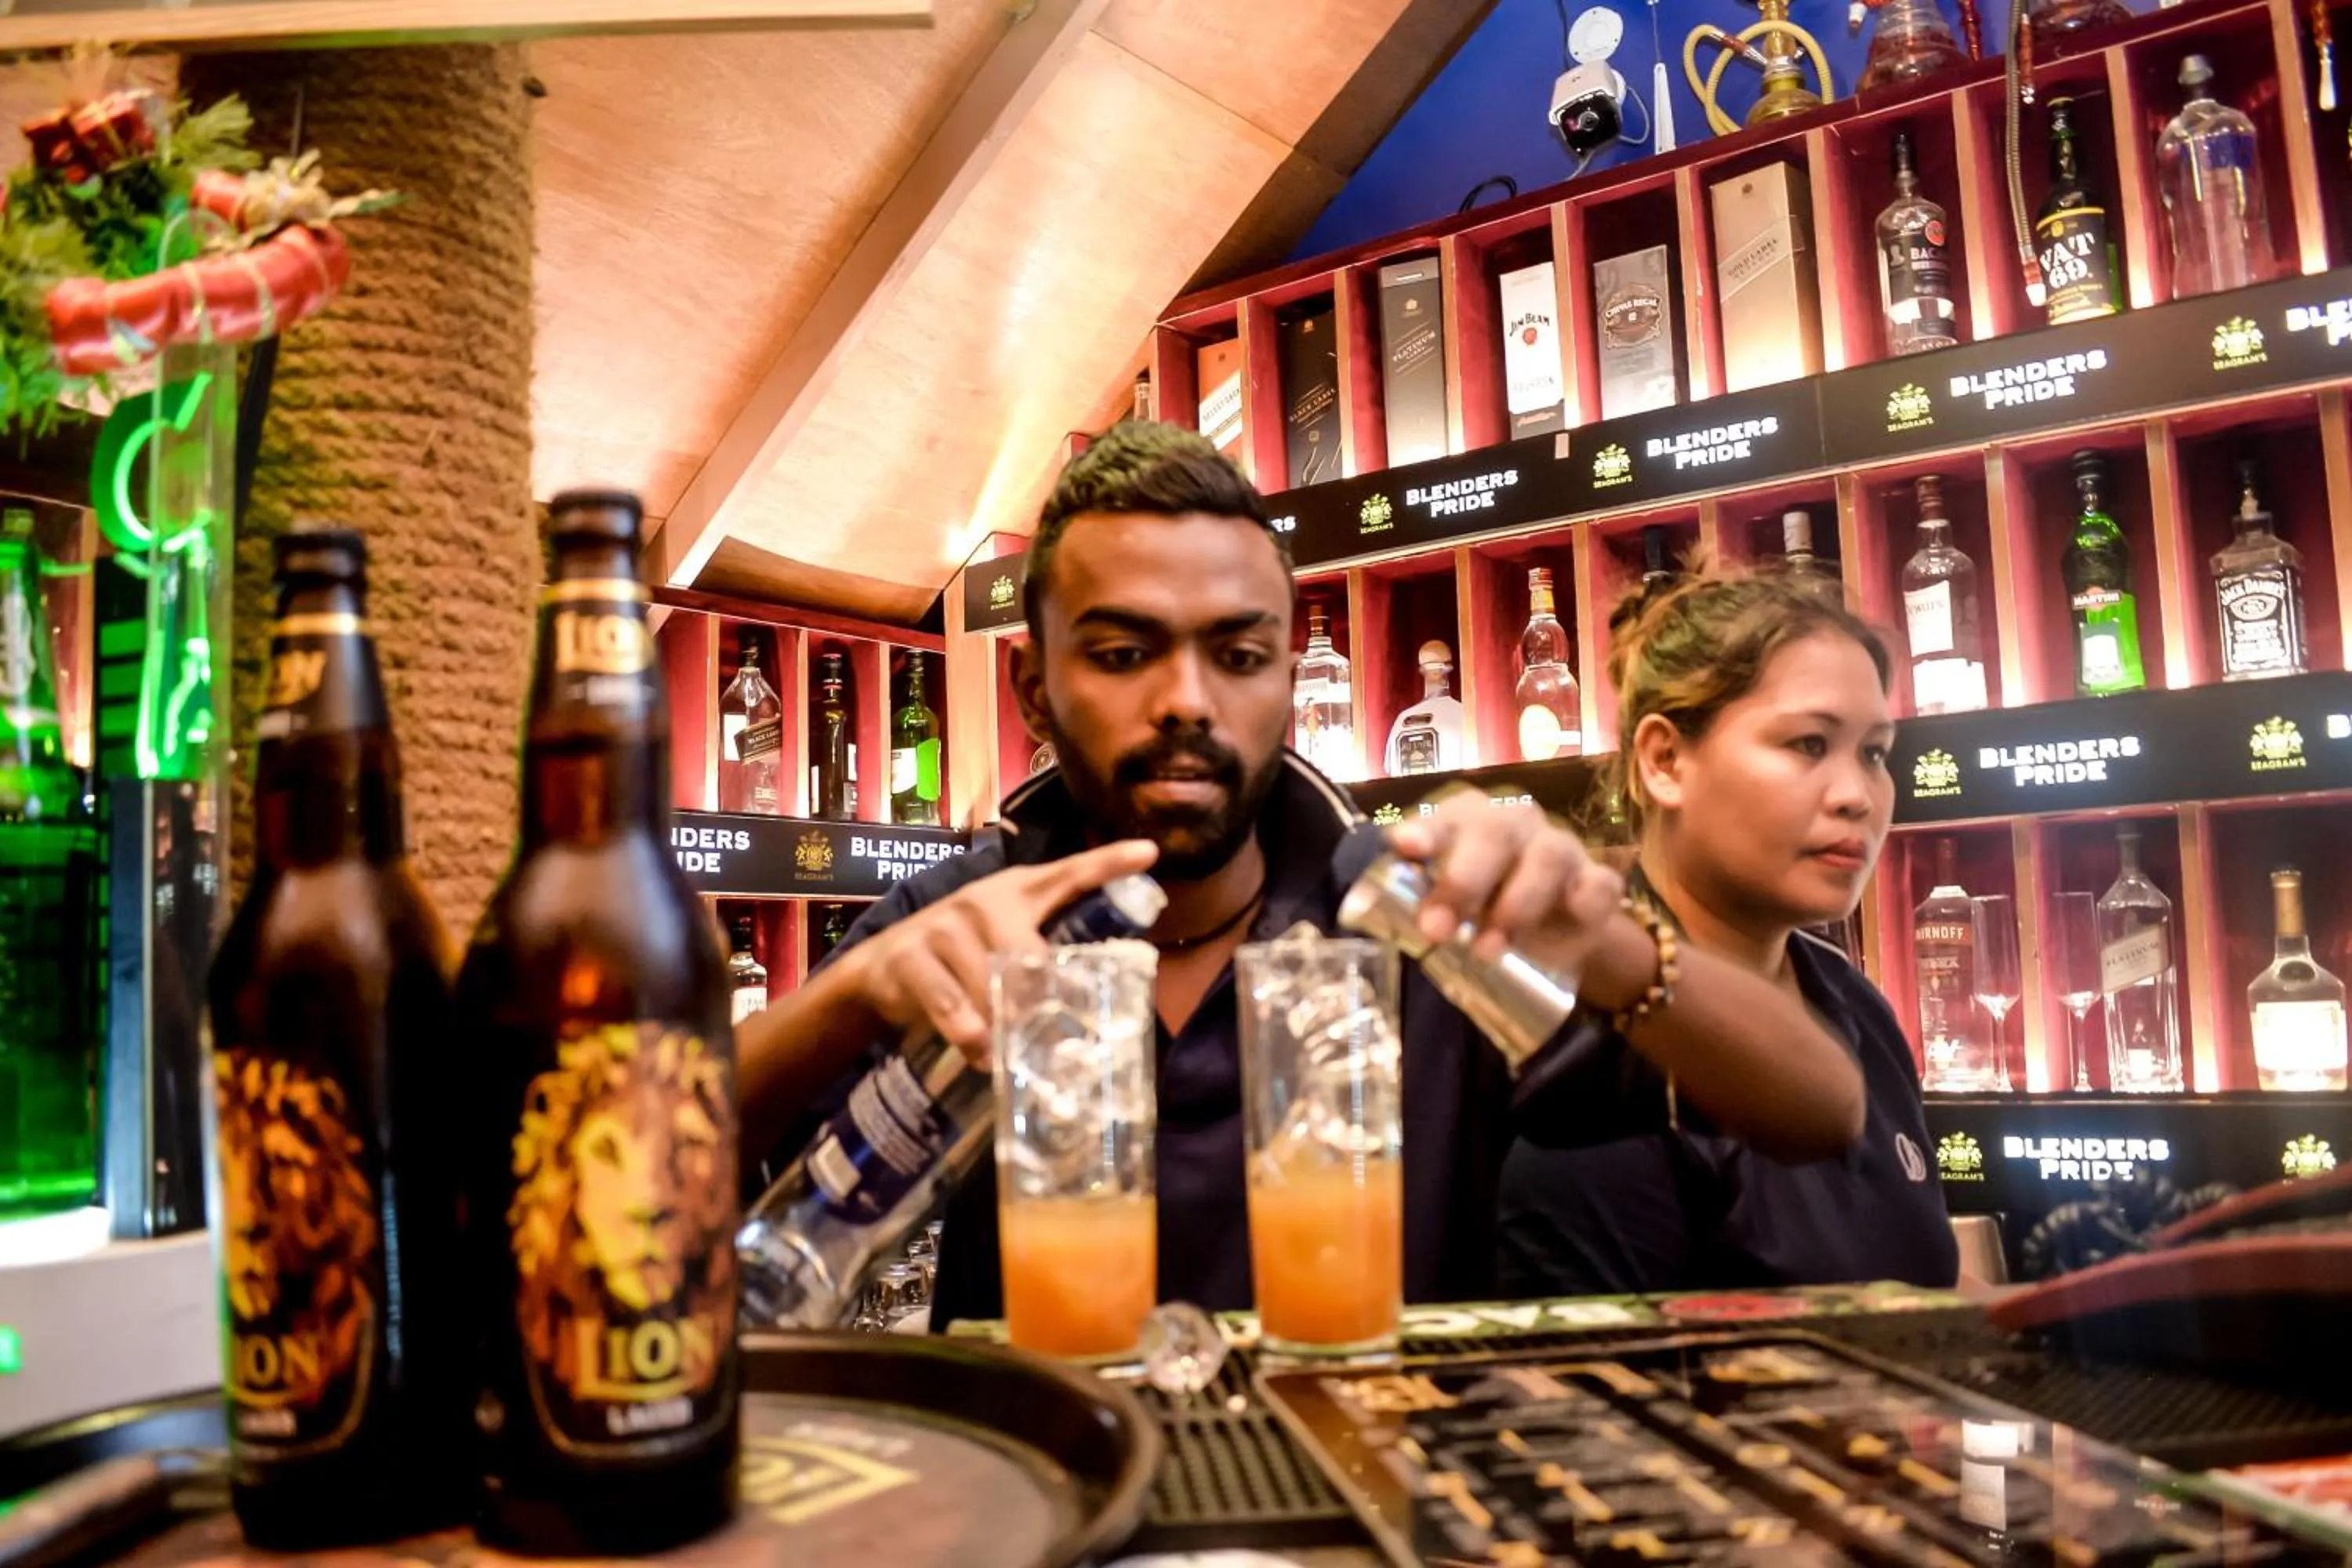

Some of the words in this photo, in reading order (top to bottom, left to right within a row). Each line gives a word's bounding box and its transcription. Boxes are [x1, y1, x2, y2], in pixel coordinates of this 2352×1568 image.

[2039, 232, 2095, 272] VAT
[1525, 312, 1550, 327] BEAM
[1605, 301, 1632, 318] CHIVAS
[1633, 298, 1658, 308] REGAL
[1950, 350, 2107, 397] BLENDERS
[1985, 376, 2075, 410] PRIDE
[1646, 416, 1779, 457] BLENDERS
[1675, 440, 1751, 470] PRIDE
[1406, 470, 1518, 506] BLENDERS
[1431, 491, 1494, 518] PRIDE
[2074, 593, 2120, 607] MARTINI
[1979, 736, 2140, 769] BLENDERS
[2013, 760, 2107, 786] PRIDE
[671, 826, 750, 851] DERS
[851, 836, 966, 861] BLENDERS
[677, 851, 721, 873] IDE
[877, 859, 935, 880] PRI
[2003, 1136, 2169, 1161] BLENDERS
[2039, 1159, 2133, 1181] PRIDE
[573, 1314, 715, 1403] LION
